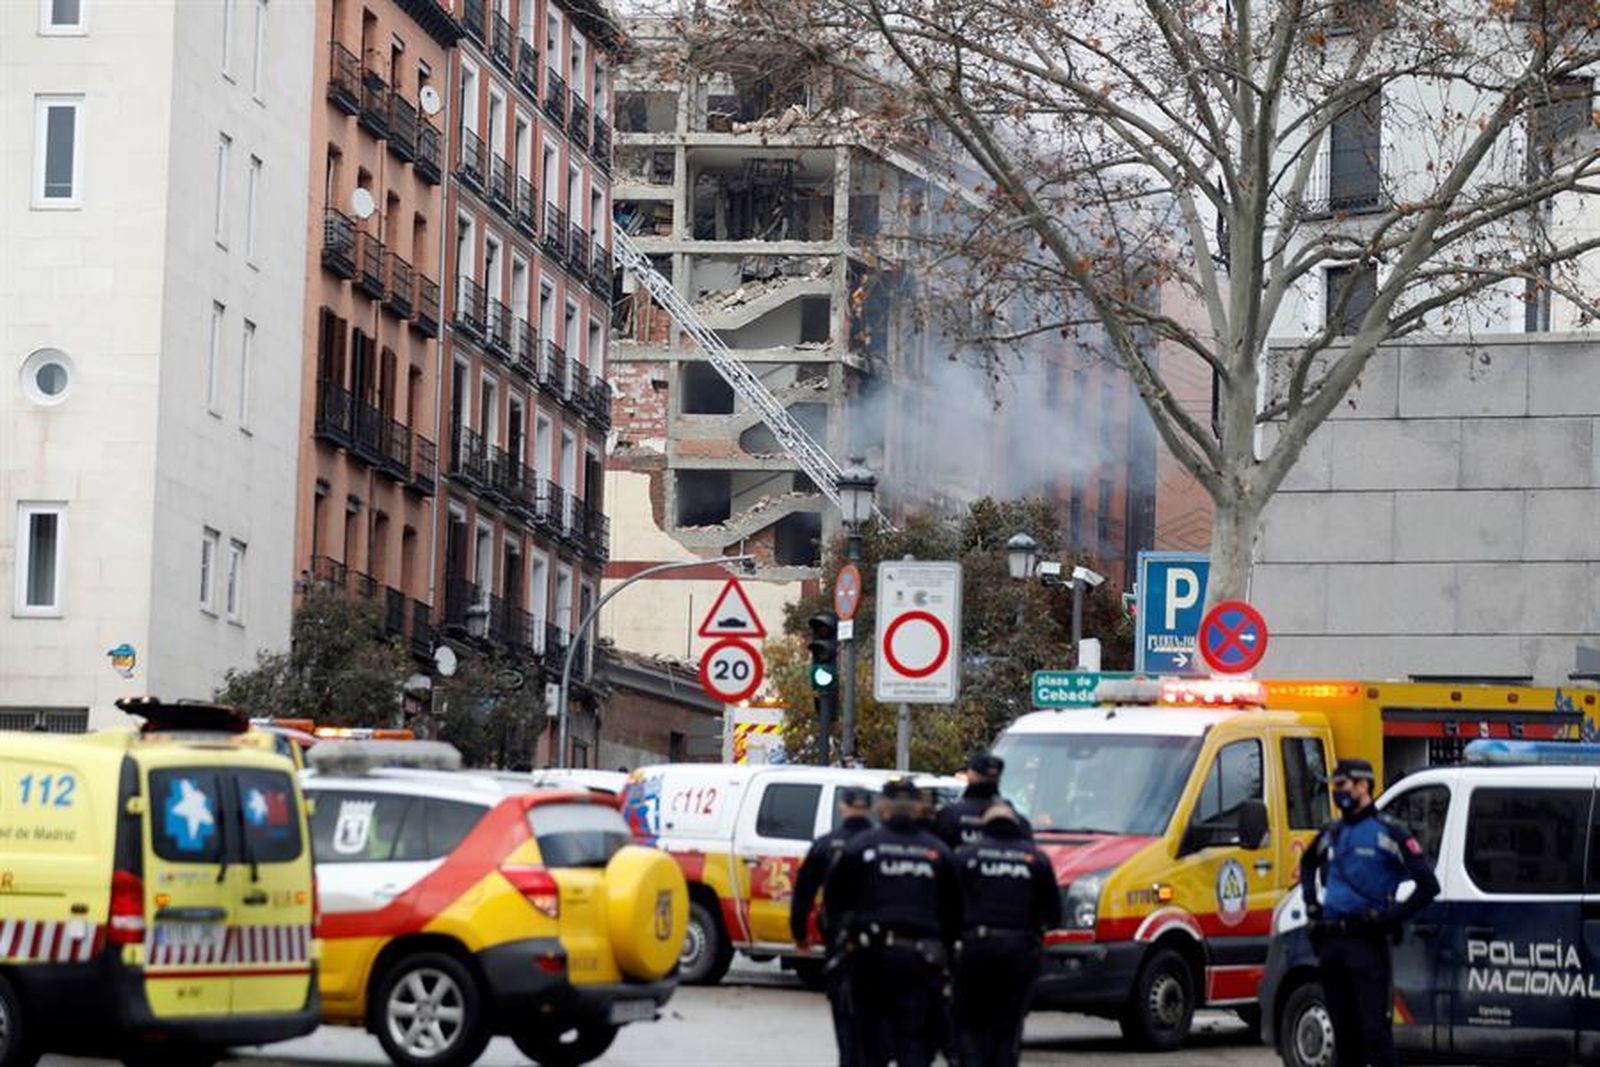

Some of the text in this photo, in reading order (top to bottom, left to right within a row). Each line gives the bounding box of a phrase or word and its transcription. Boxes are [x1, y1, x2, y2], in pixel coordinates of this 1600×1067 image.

[1166, 567, 1199, 630] P
[714, 660, 749, 681] 20
[1038, 676, 1069, 687] plaza
[1077, 676, 1091, 686] de
[19, 774, 75, 806] 112
[33, 826, 76, 842] Madrid
[1467, 938, 1581, 969] POLICÍA
[1467, 967, 1600, 998] NACIONAL
